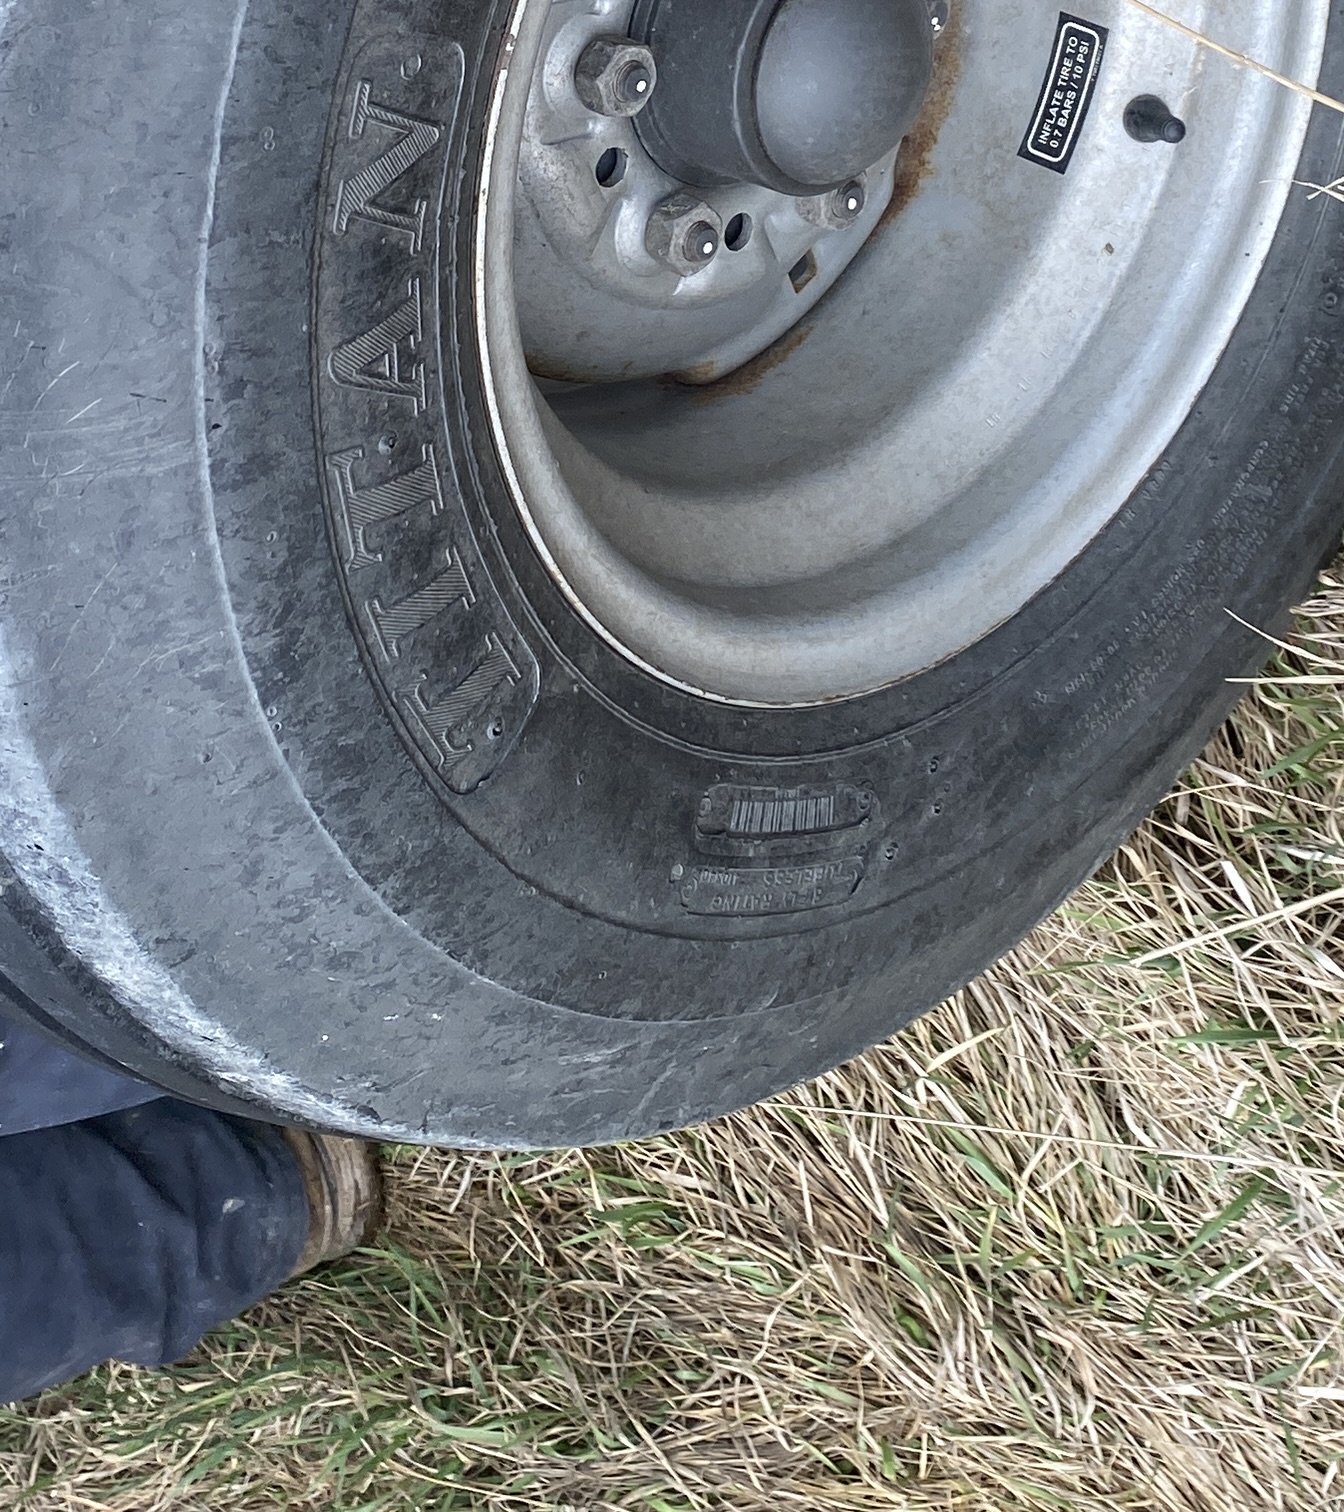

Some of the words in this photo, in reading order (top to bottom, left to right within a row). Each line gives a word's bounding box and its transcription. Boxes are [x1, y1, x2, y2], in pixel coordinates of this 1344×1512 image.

[1038, 89, 1064, 145] INFLATE
[1057, 56, 1074, 86] TIRE
[1066, 36, 1078, 54] TO
[1059, 90, 1077, 128] BARS
[1072, 65, 1084, 81] 10
[1078, 41, 1090, 63] PSI
[326, 79, 522, 770] TITAN
[708, 889, 773, 912] RATING
[761, 860, 843, 887] TUBELESS
